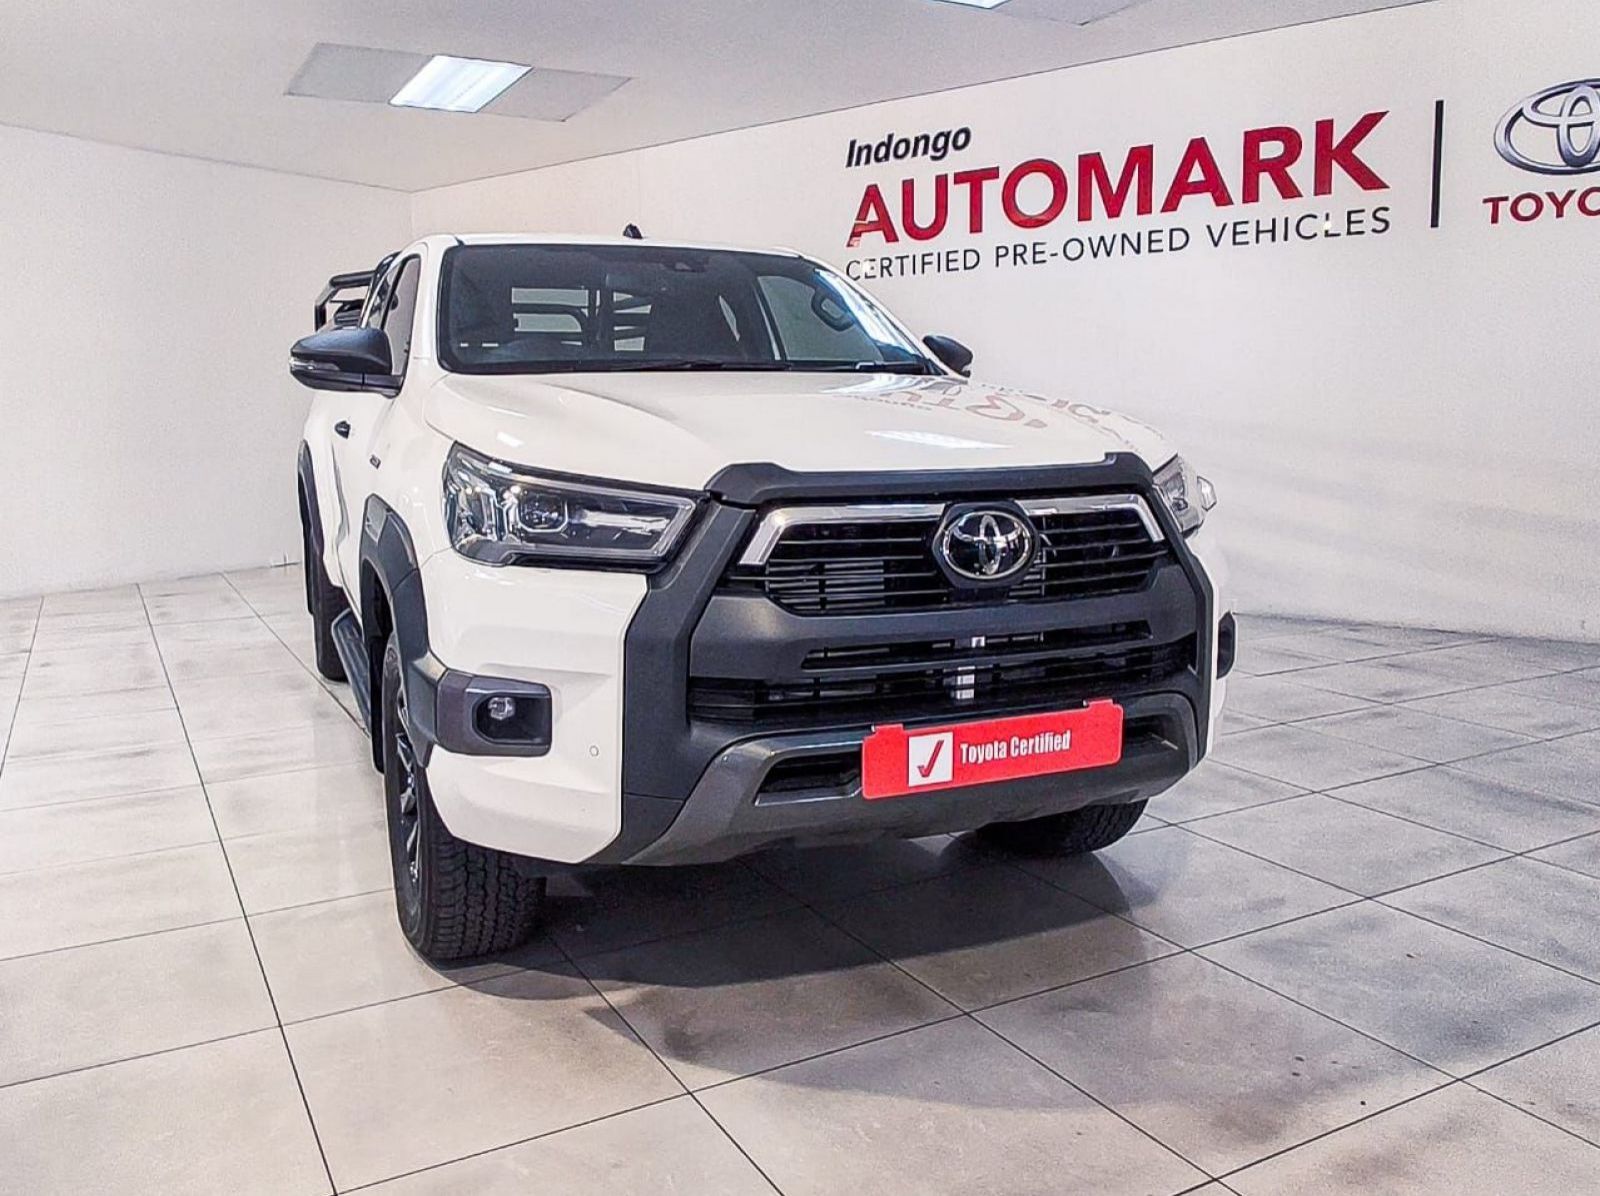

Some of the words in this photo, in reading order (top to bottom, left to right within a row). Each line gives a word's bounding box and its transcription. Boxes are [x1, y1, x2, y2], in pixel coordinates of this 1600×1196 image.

[845, 126, 972, 168] Indongo
[846, 110, 1391, 248] AUTOMARK
[845, 248, 981, 282] CERTIFIED
[995, 226, 1190, 268] PRE-OWNED
[1206, 206, 1391, 248] VEHICLES
[959, 740, 1008, 766] Toyota
[1009, 730, 1072, 758] Certified
